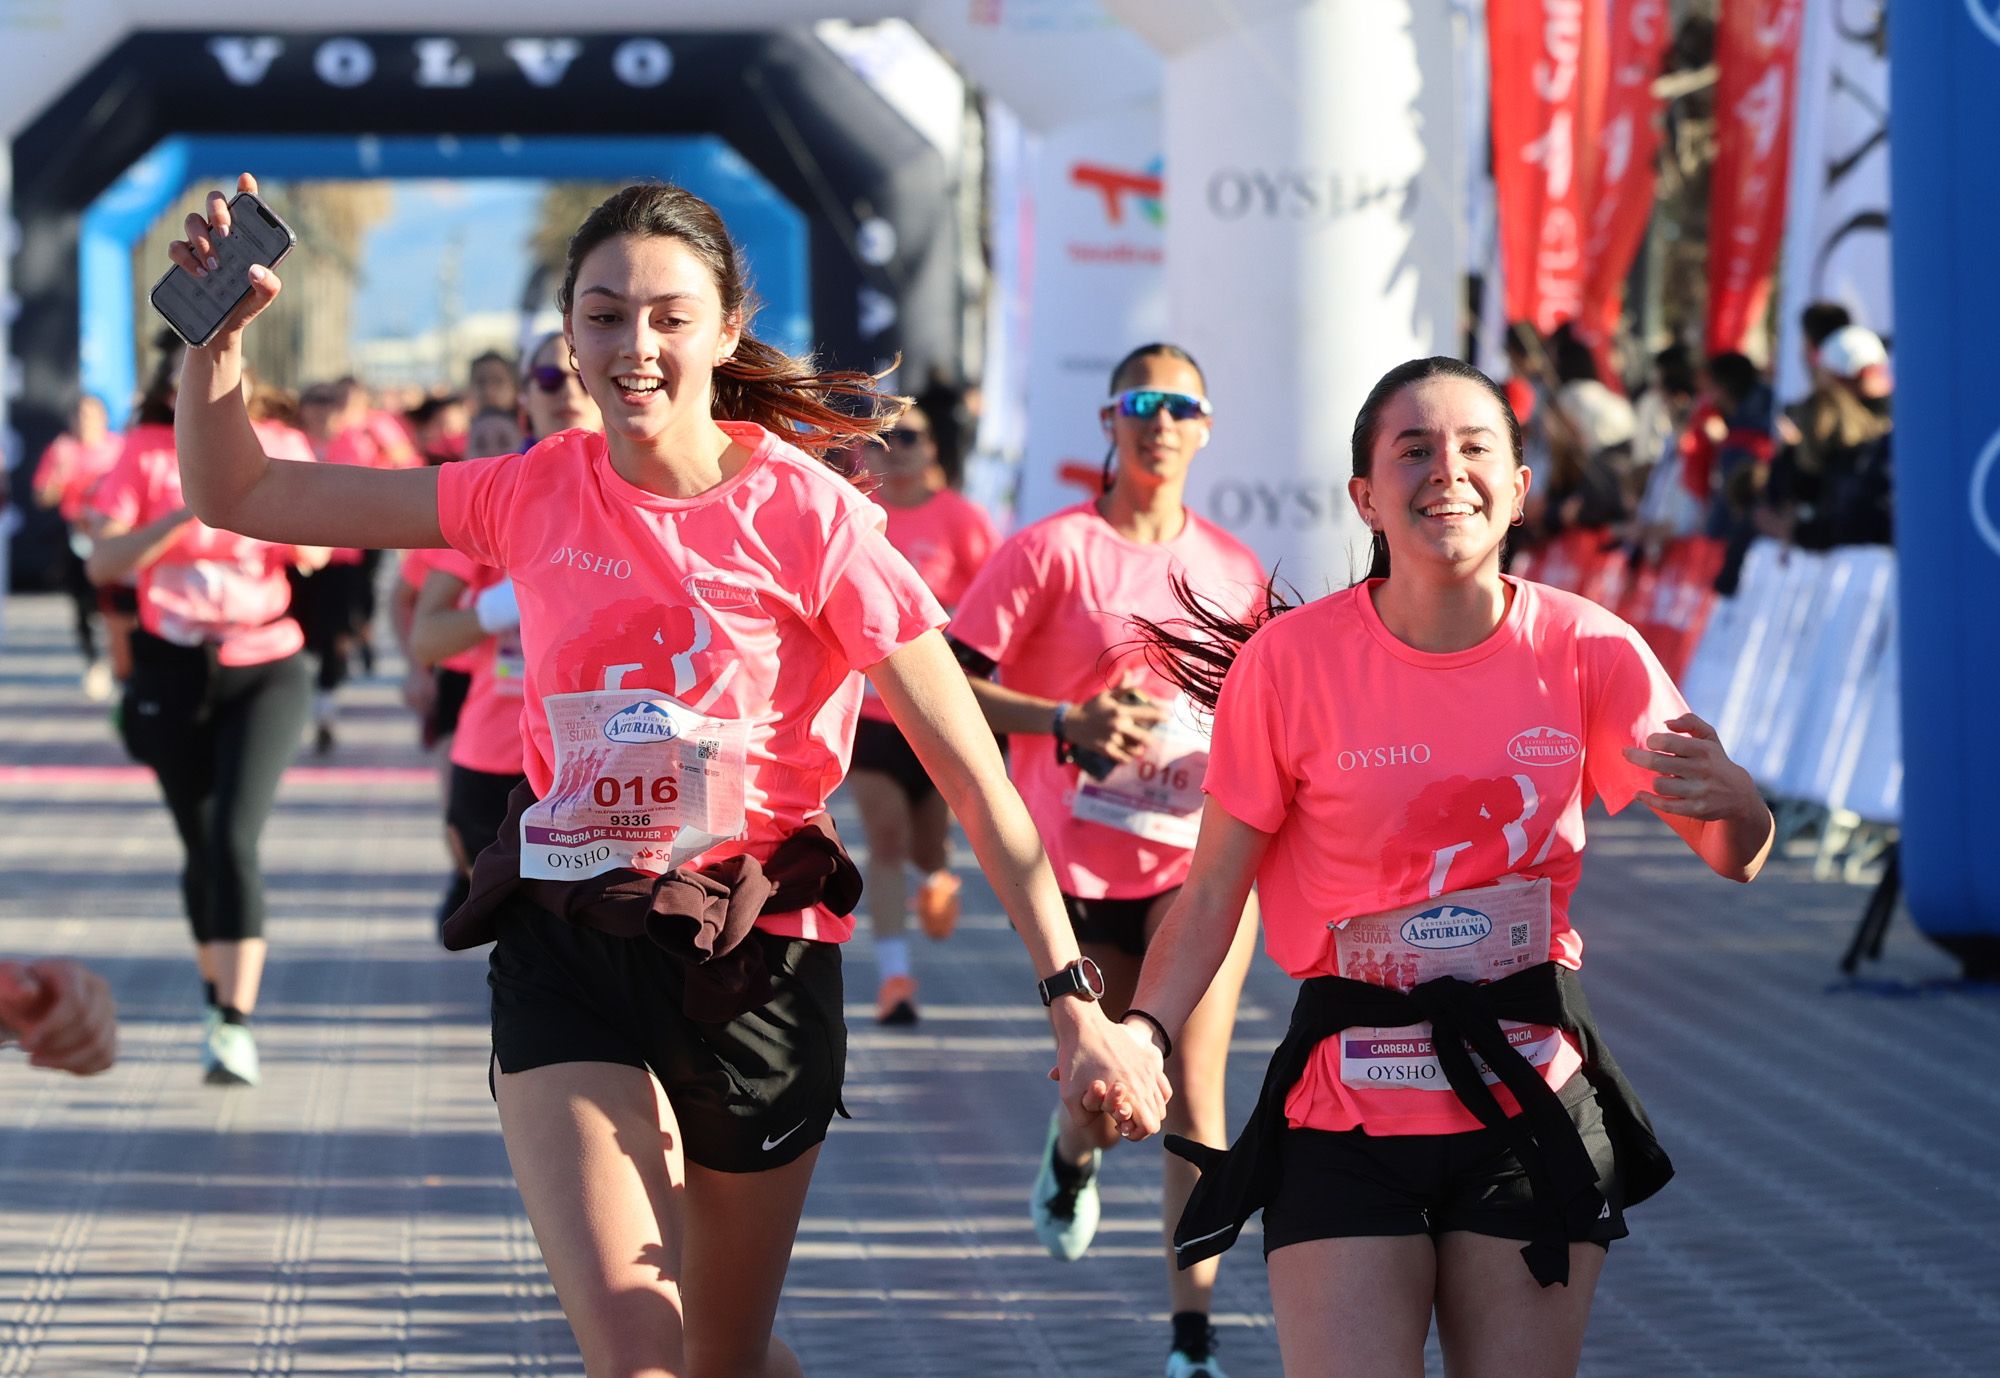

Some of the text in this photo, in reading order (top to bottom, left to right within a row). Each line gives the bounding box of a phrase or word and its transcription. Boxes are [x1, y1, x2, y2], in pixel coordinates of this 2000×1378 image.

[206, 37, 676, 88] VOLVO
[569, 729, 598, 742] SUMA
[609, 719, 672, 736] ASTURIANA
[1337, 744, 1431, 771] OYSHO
[1514, 741, 1577, 757] ASTURIANA
[1137, 761, 1189, 791] 016
[593, 775, 679, 807] 016
[610, 814, 651, 826] 9336
[549, 832, 591, 844] CARRERA
[593, 829, 606, 838] DE
[609, 830, 623, 838] LA
[626, 831, 661, 839] MUJER
[547, 846, 610, 869] OYSHO
[1353, 931, 1392, 945] SUMA
[1407, 923, 1486, 940] ASTURIANA
[1370, 1030, 1532, 1055] CARRERA DE ENCIA
[1367, 1064, 1436, 1081] OYSHO
